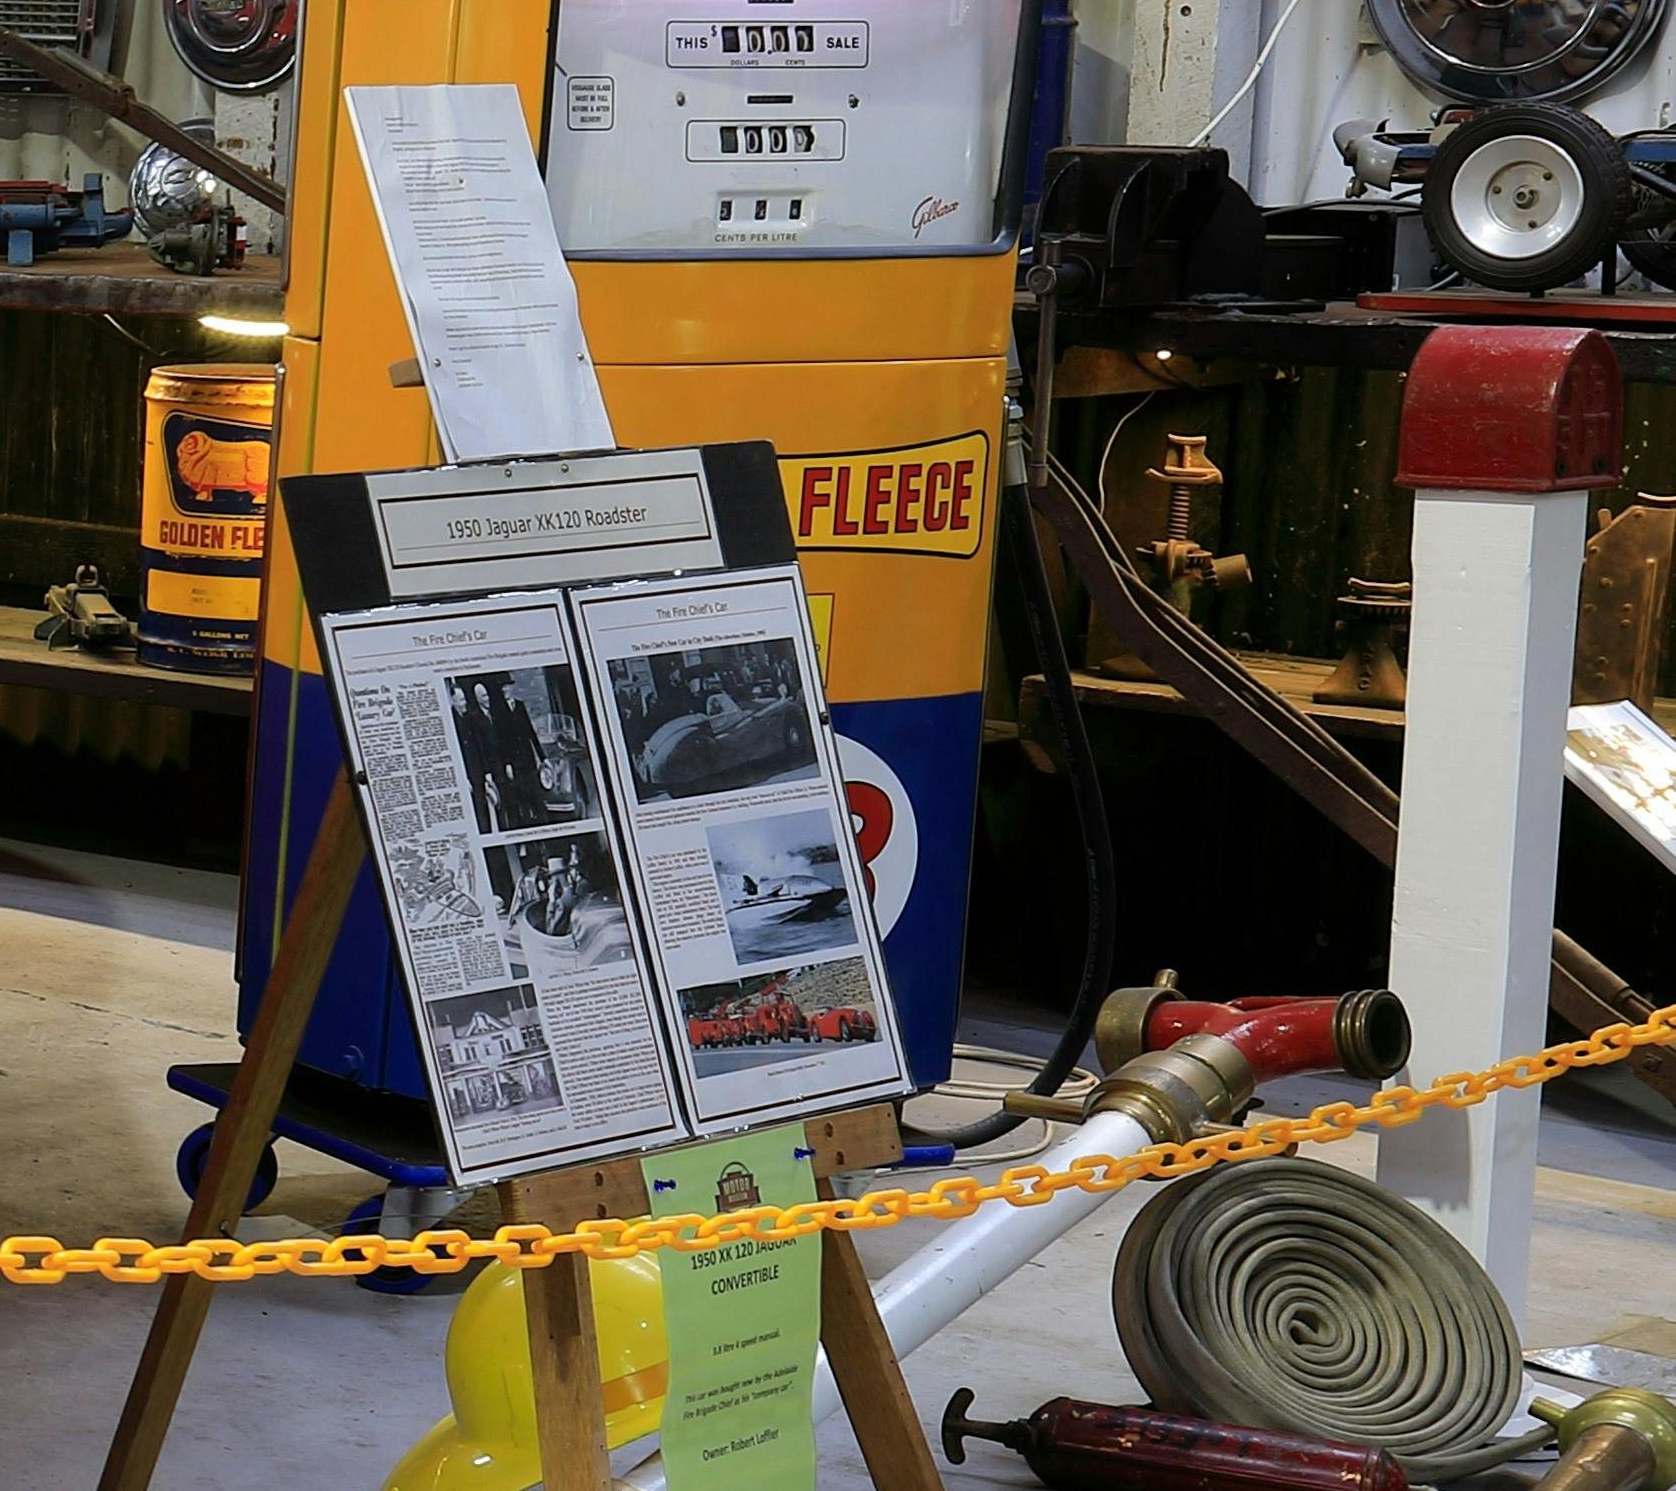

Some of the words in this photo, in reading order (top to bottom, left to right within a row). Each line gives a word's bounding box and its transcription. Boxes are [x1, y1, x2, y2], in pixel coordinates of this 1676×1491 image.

[676, 37, 708, 50] THIS
[826, 37, 861, 50] SALE
[730, 59, 759, 67] DOLLARS
[785, 59, 806, 67] CENTS
[715, 233, 746, 242] CENTS
[750, 233, 768, 242] PER
[771, 233, 798, 242] LITRE
[798, 461, 974, 537] FLEECE
[160, 520, 225, 549] GOLDEN
[446, 518, 482, 540] 1950
[485, 515, 532, 541] Jaguar
[535, 509, 582, 532] XK120
[585, 505, 647, 529] Roadster
[656, 608, 671, 620] The
[672, 606, 688, 618] Fire
[688, 602, 714, 617] Chief's
[714, 602, 729, 612] Car
[412, 635, 428, 647] The
[429, 633, 445, 646] Fire
[446, 630, 473, 645] Chief's
[473, 629, 488, 642] Car
[691, 1250, 717, 1270] 1950
[718, 1246, 733, 1264] XK
[735, 1243, 754, 1261] 120
[711, 1264, 780, 1296] CONVERTIBLE
[720, 1377, 741, 1395] bought
[683, 1407, 694, 1421] Fire
[695, 1400, 718, 1420] Brigade
[718, 1396, 733, 1413] Chief
[702, 1444, 730, 1463] Owner:
[731, 1433, 755, 1454] Robert
